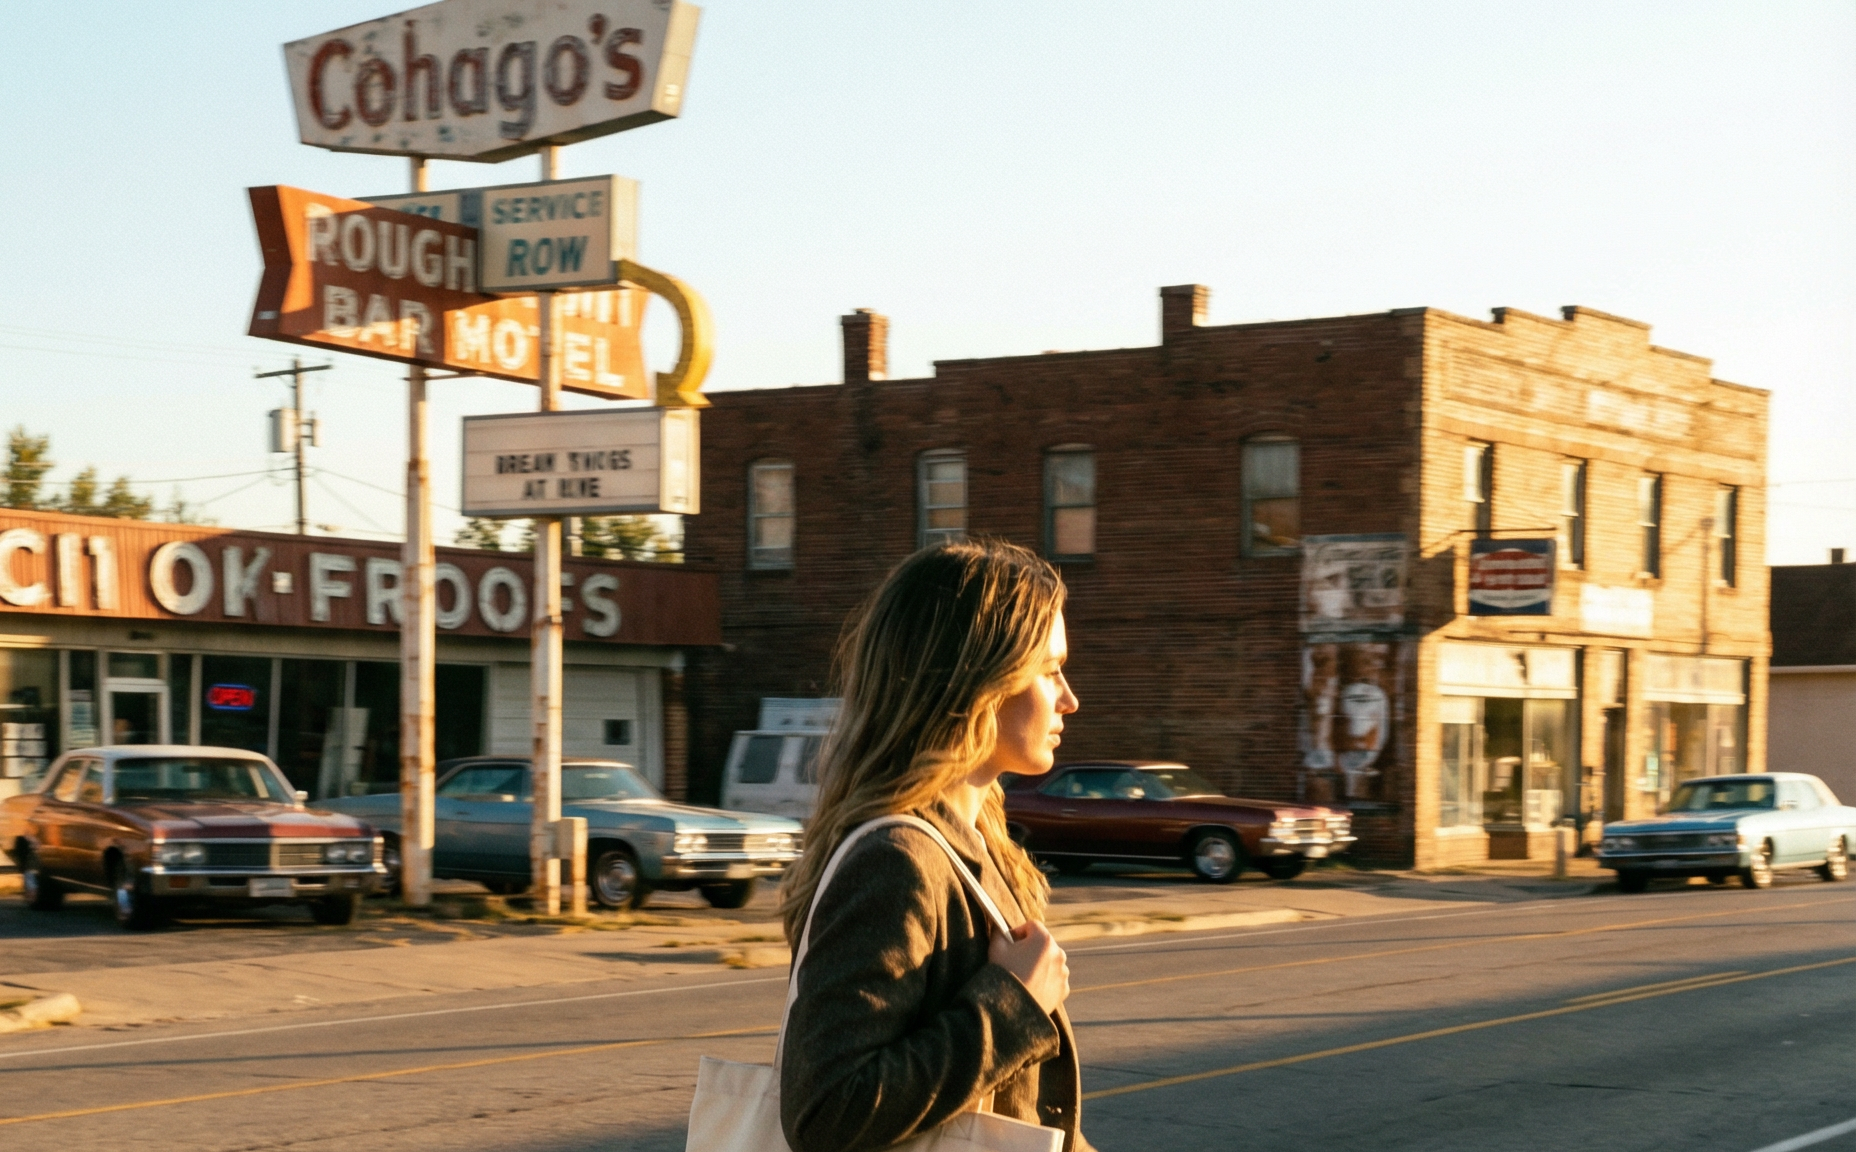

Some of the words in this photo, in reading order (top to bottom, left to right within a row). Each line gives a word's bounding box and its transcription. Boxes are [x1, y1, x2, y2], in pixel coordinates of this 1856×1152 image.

[307, 13, 644, 140] Cohago's
[304, 202, 477, 292] ROUGH
[492, 189, 604, 225] SERVICE
[505, 236, 589, 277] ROW
[323, 285, 434, 354] BAR
[455, 310, 625, 387] MOEL
